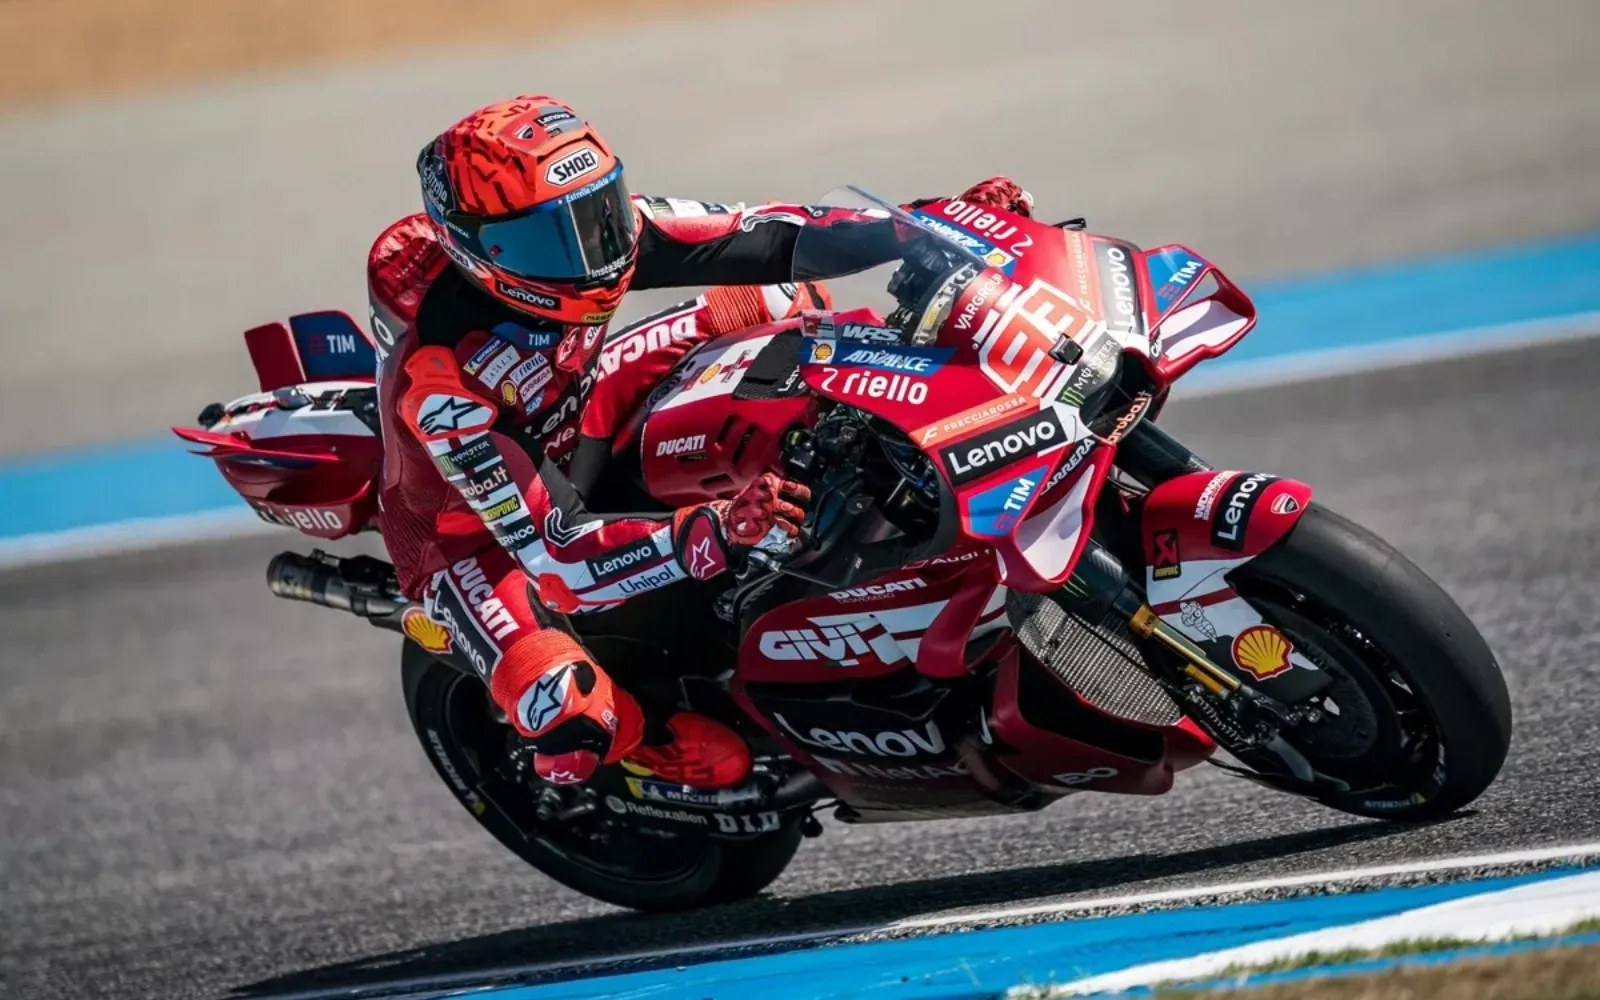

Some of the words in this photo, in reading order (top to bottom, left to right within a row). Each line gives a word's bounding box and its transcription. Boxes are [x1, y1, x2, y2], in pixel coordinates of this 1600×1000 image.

[553, 151, 597, 182] SHOEI
[566, 185, 591, 203] Estrella
[944, 200, 1018, 241] riello
[591, 256, 627, 278] Insta360
[1168, 260, 1202, 285] TIM
[499, 283, 556, 308] Lenovo
[1107, 247, 1134, 328] Lenovo
[326, 334, 356, 353] TIM
[527, 333, 551, 347] TIM
[597, 313, 697, 377] DUCA
[842, 324, 903, 341] WRS
[517, 353, 548, 380] riello
[841, 349, 933, 372] ADVANCE
[841, 371, 929, 405] riello
[943, 397, 1028, 433] FRECCIAROSSA
[451, 440, 490, 463] MONSTER
[655, 434, 706, 457] DUCATI
[947, 420, 1056, 475] Lenovo
[463, 466, 509, 497] ruba.it
[1042, 437, 1096, 495] ARRERA
[1003, 477, 1036, 511] TIM
[1217, 472, 1277, 541] Lenov
[593, 546, 652, 577] Lenovo
[931, 550, 978, 565] Audi
[618, 565, 675, 595] Unipol
[827, 577, 926, 600] DUCATI
[452, 556, 520, 641] DUCATI
[434, 590, 486, 676] Lenovo
[759, 622, 872, 662] GIVI
[772, 711, 946, 757] Lenov
[626, 802, 709, 825] Reflexallen
